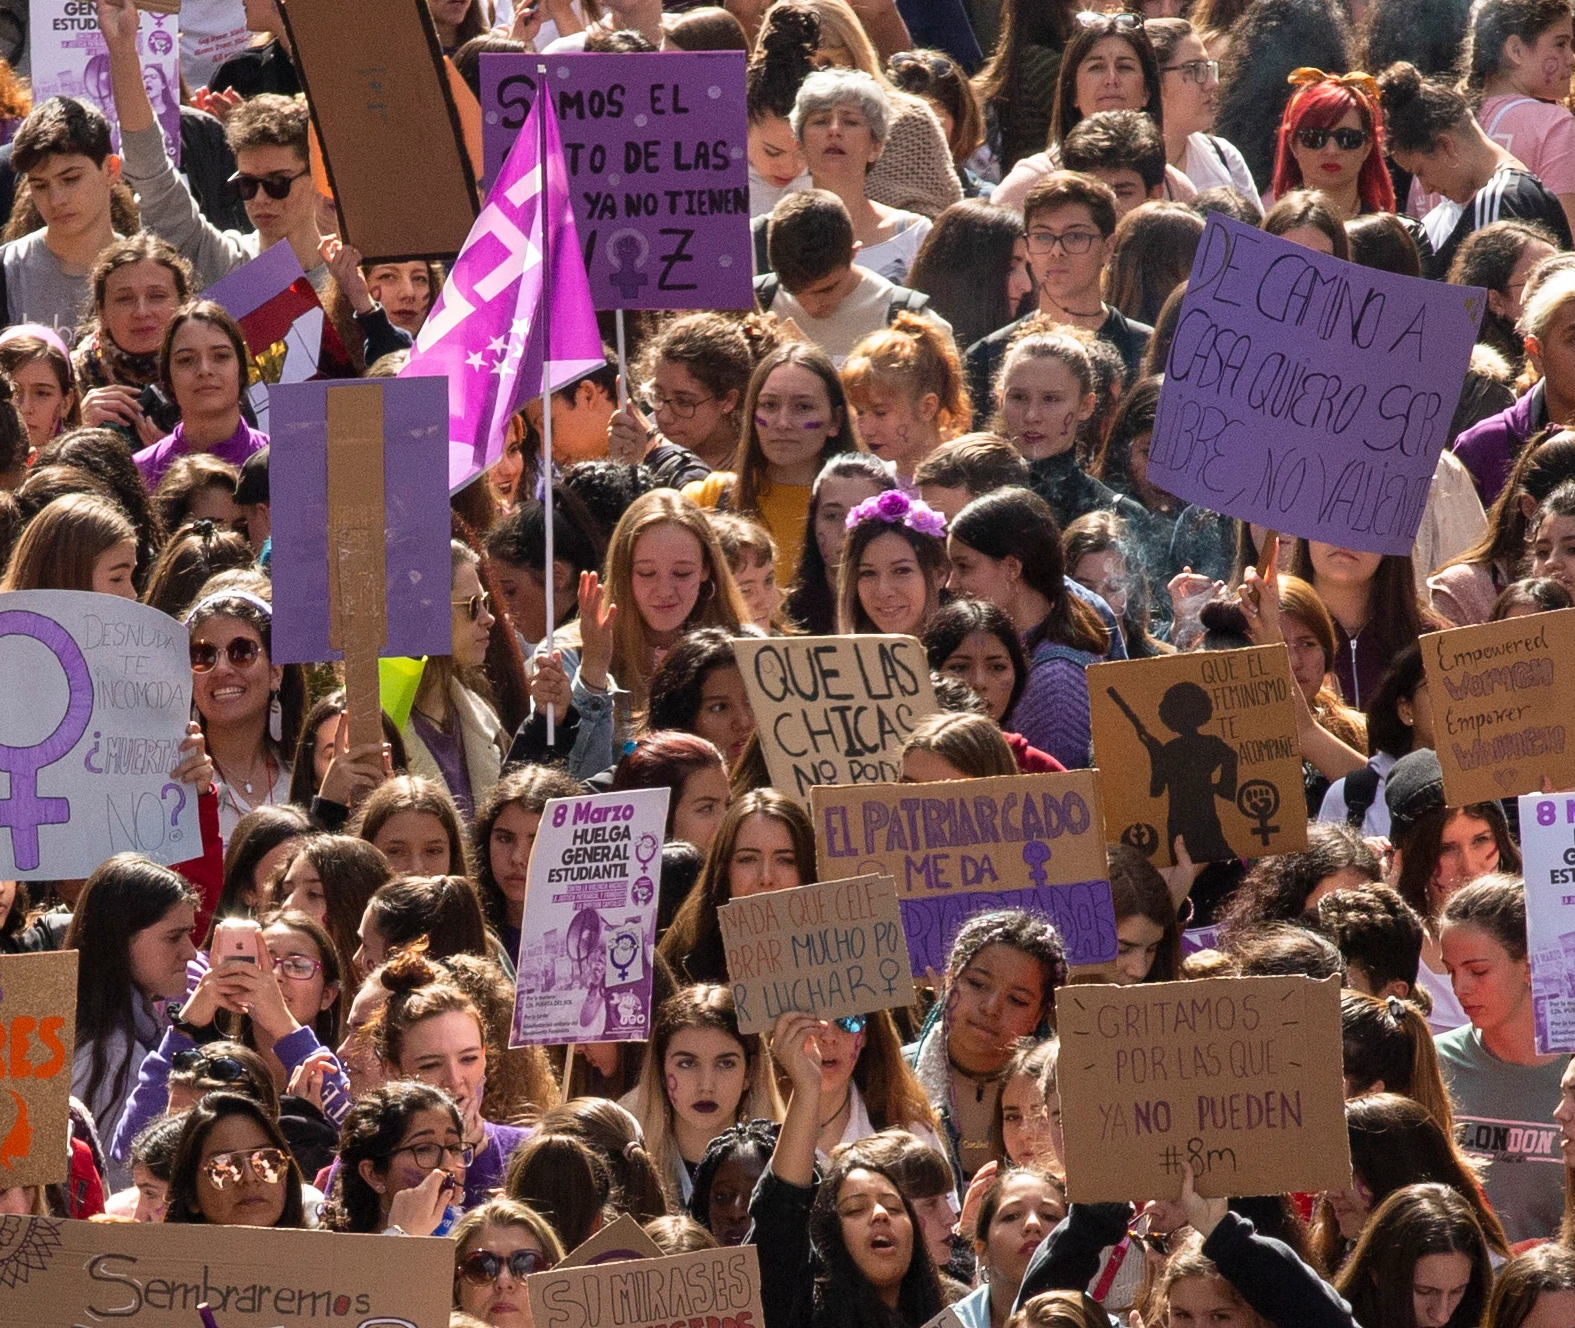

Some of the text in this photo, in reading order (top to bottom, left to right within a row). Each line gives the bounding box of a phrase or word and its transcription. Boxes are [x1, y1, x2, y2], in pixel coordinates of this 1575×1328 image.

[624, 140, 732, 174] DE LAS
[584, 185, 751, 220] YA NO TIENEN
[83, 614, 177, 651] DESNUDA
[753, 643, 920, 702] QUE LAS
[1201, 653, 1270, 684] QUE EL
[1213, 677, 1286, 711] FEMINISMO
[1216, 715, 1239, 739] TE
[551, 801, 635, 828] 8 Marzo
[824, 790, 1091, 858] EL PATRIARCADO
[1536, 800, 1556, 826] 8
[572, 825, 632, 846] HUELGA
[561, 844, 631, 866] GENERAL
[904, 853, 999, 892] ME DA
[547, 863, 629, 884] ESTUDIANTIL
[729, 938, 785, 981] BRAR
[792, 924, 866, 969] MUCHO
[874, 920, 899, 955] PO
[1097, 996, 1261, 1039] GRITAMOS
[1116, 1040, 1279, 1085] POR LAS QUE
[1098, 1091, 1303, 1141] YA NO PUEDEN
[1463, 1124, 1556, 1155] LONDON
[83, 1253, 370, 1321] Sembraremos
[610, 1254, 752, 1325] MIRASES
